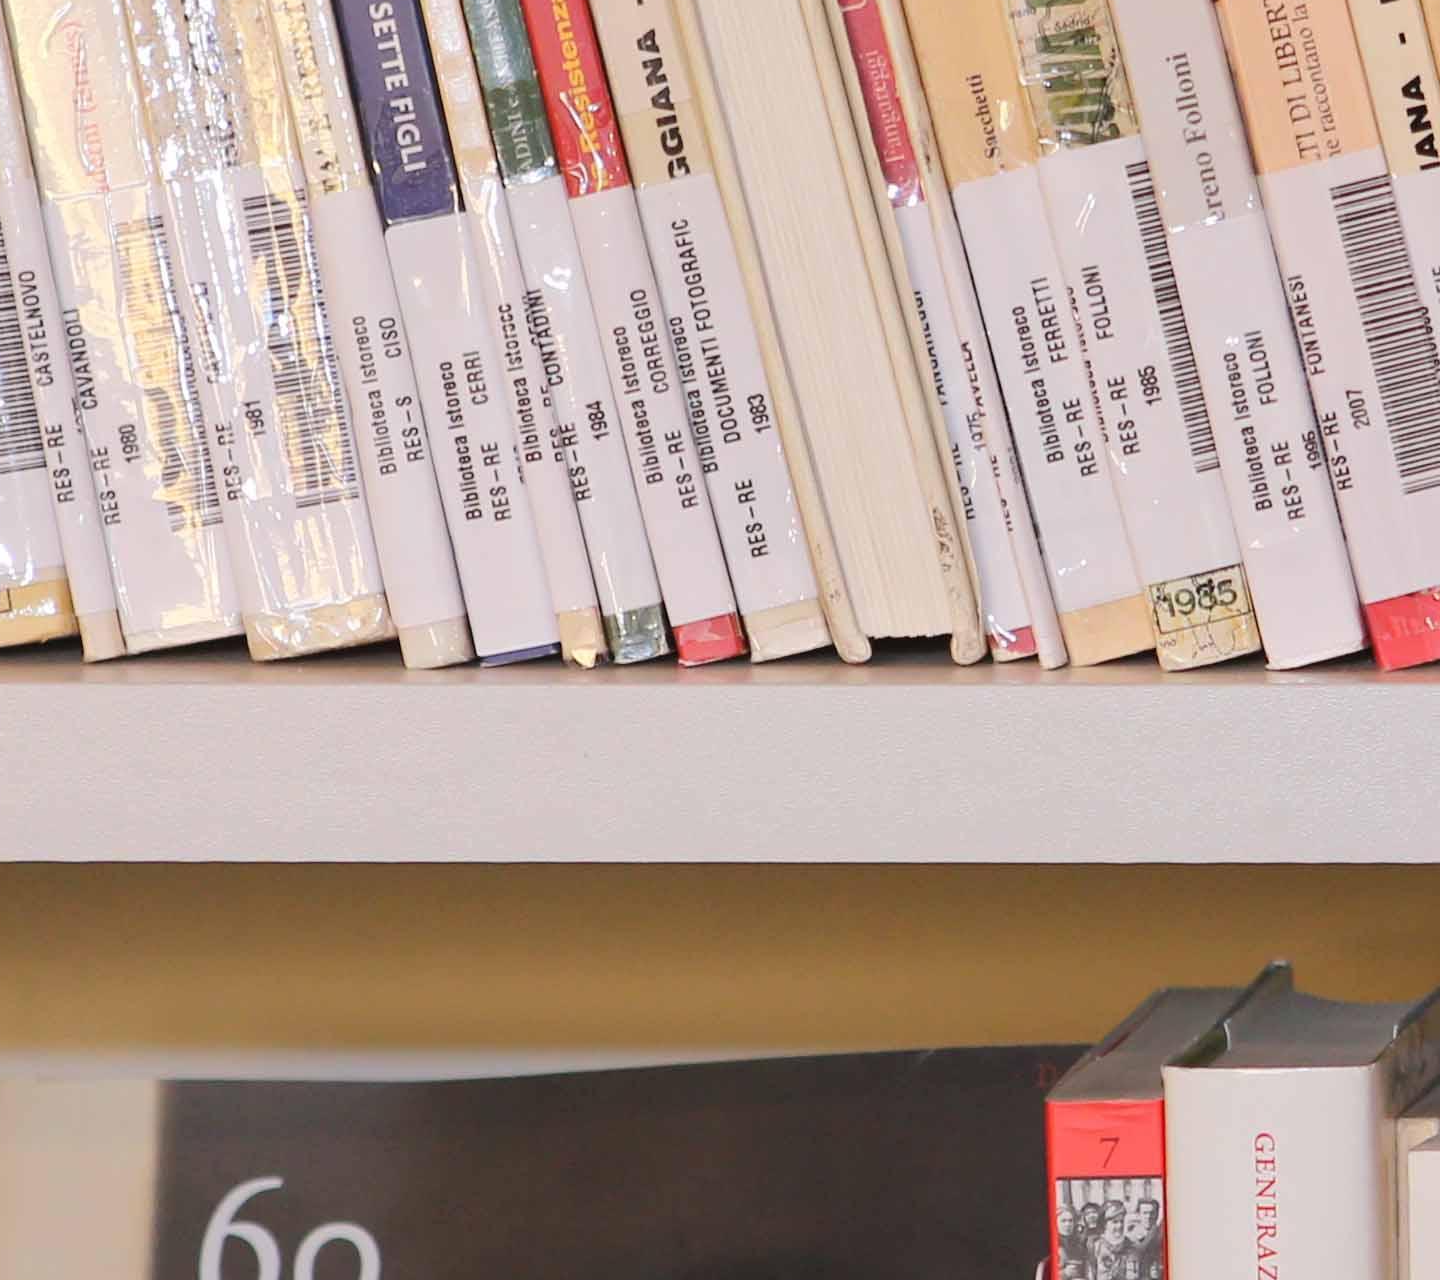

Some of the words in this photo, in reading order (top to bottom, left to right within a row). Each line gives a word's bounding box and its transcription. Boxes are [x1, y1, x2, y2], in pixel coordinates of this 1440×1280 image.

[364, 1, 405, 80] SETTE
[380, 87, 426, 173] FIGLI
[629, 288, 670, 395] CORREGGIO
